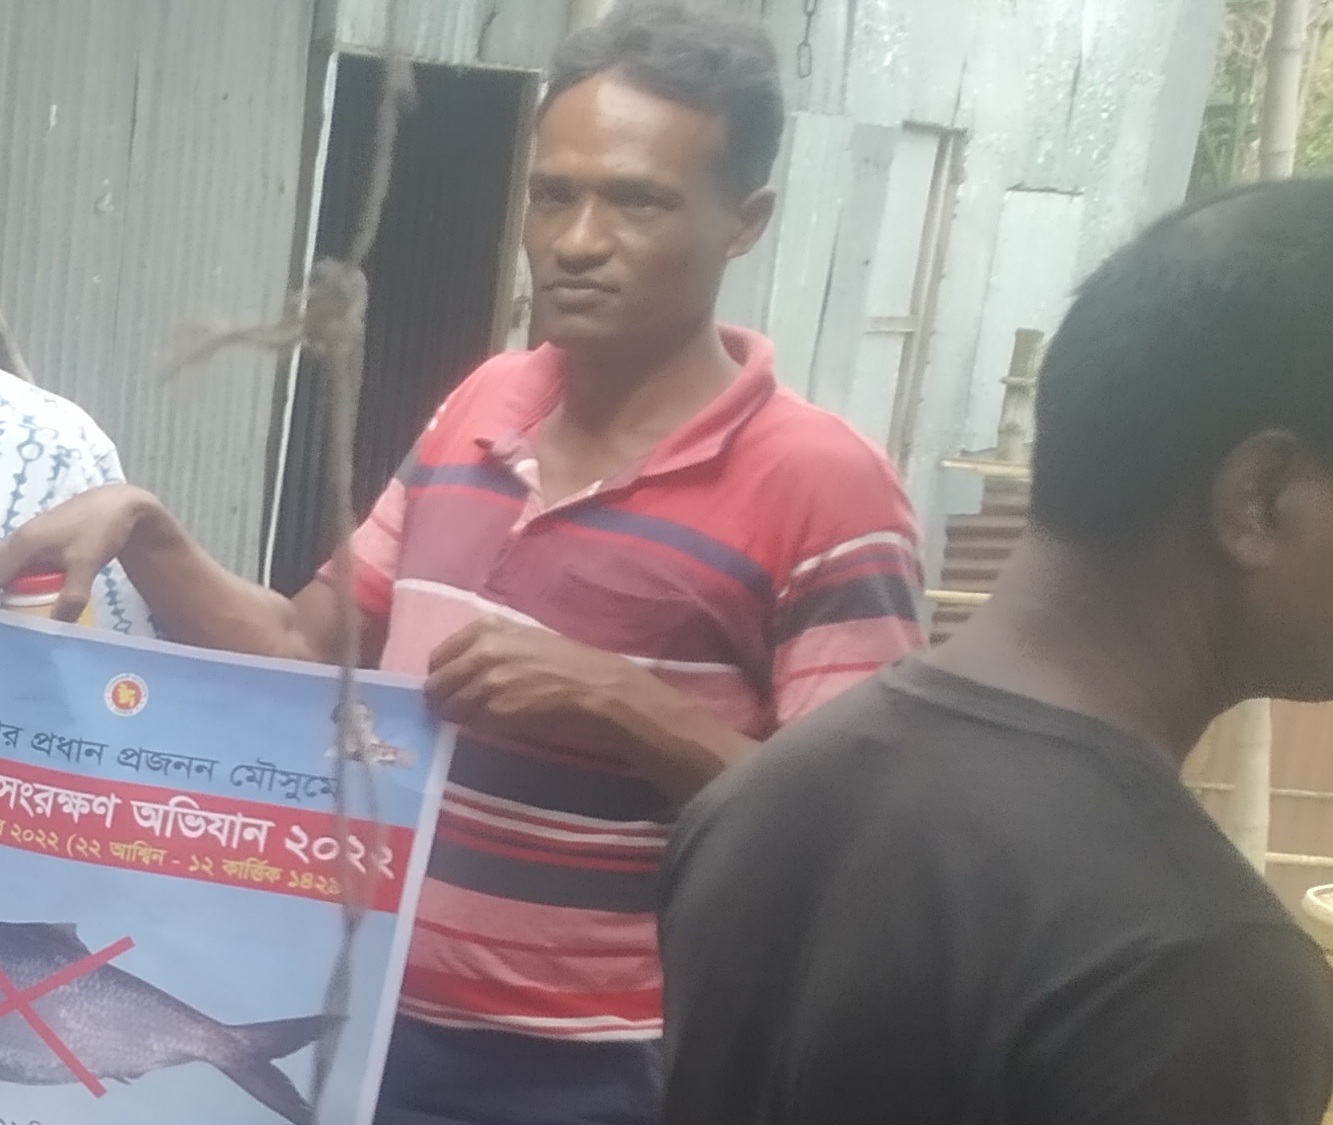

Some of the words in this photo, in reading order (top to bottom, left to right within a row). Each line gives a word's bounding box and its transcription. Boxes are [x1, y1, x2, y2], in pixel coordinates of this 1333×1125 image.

[30, 732, 109, 765] প্রধান
[116, 746, 219, 781] প্রজনন
[229, 757, 339, 802] মৌসুমে
[9, 823, 58, 851] ২০২২
[66, 833, 100, 858] (২২
[109, 839, 167, 865] আশ্বিন
[188, 854, 213, 876] ১২
[129, 794, 275, 852] অভিযান
[284, 824, 394, 879] ২০২২
